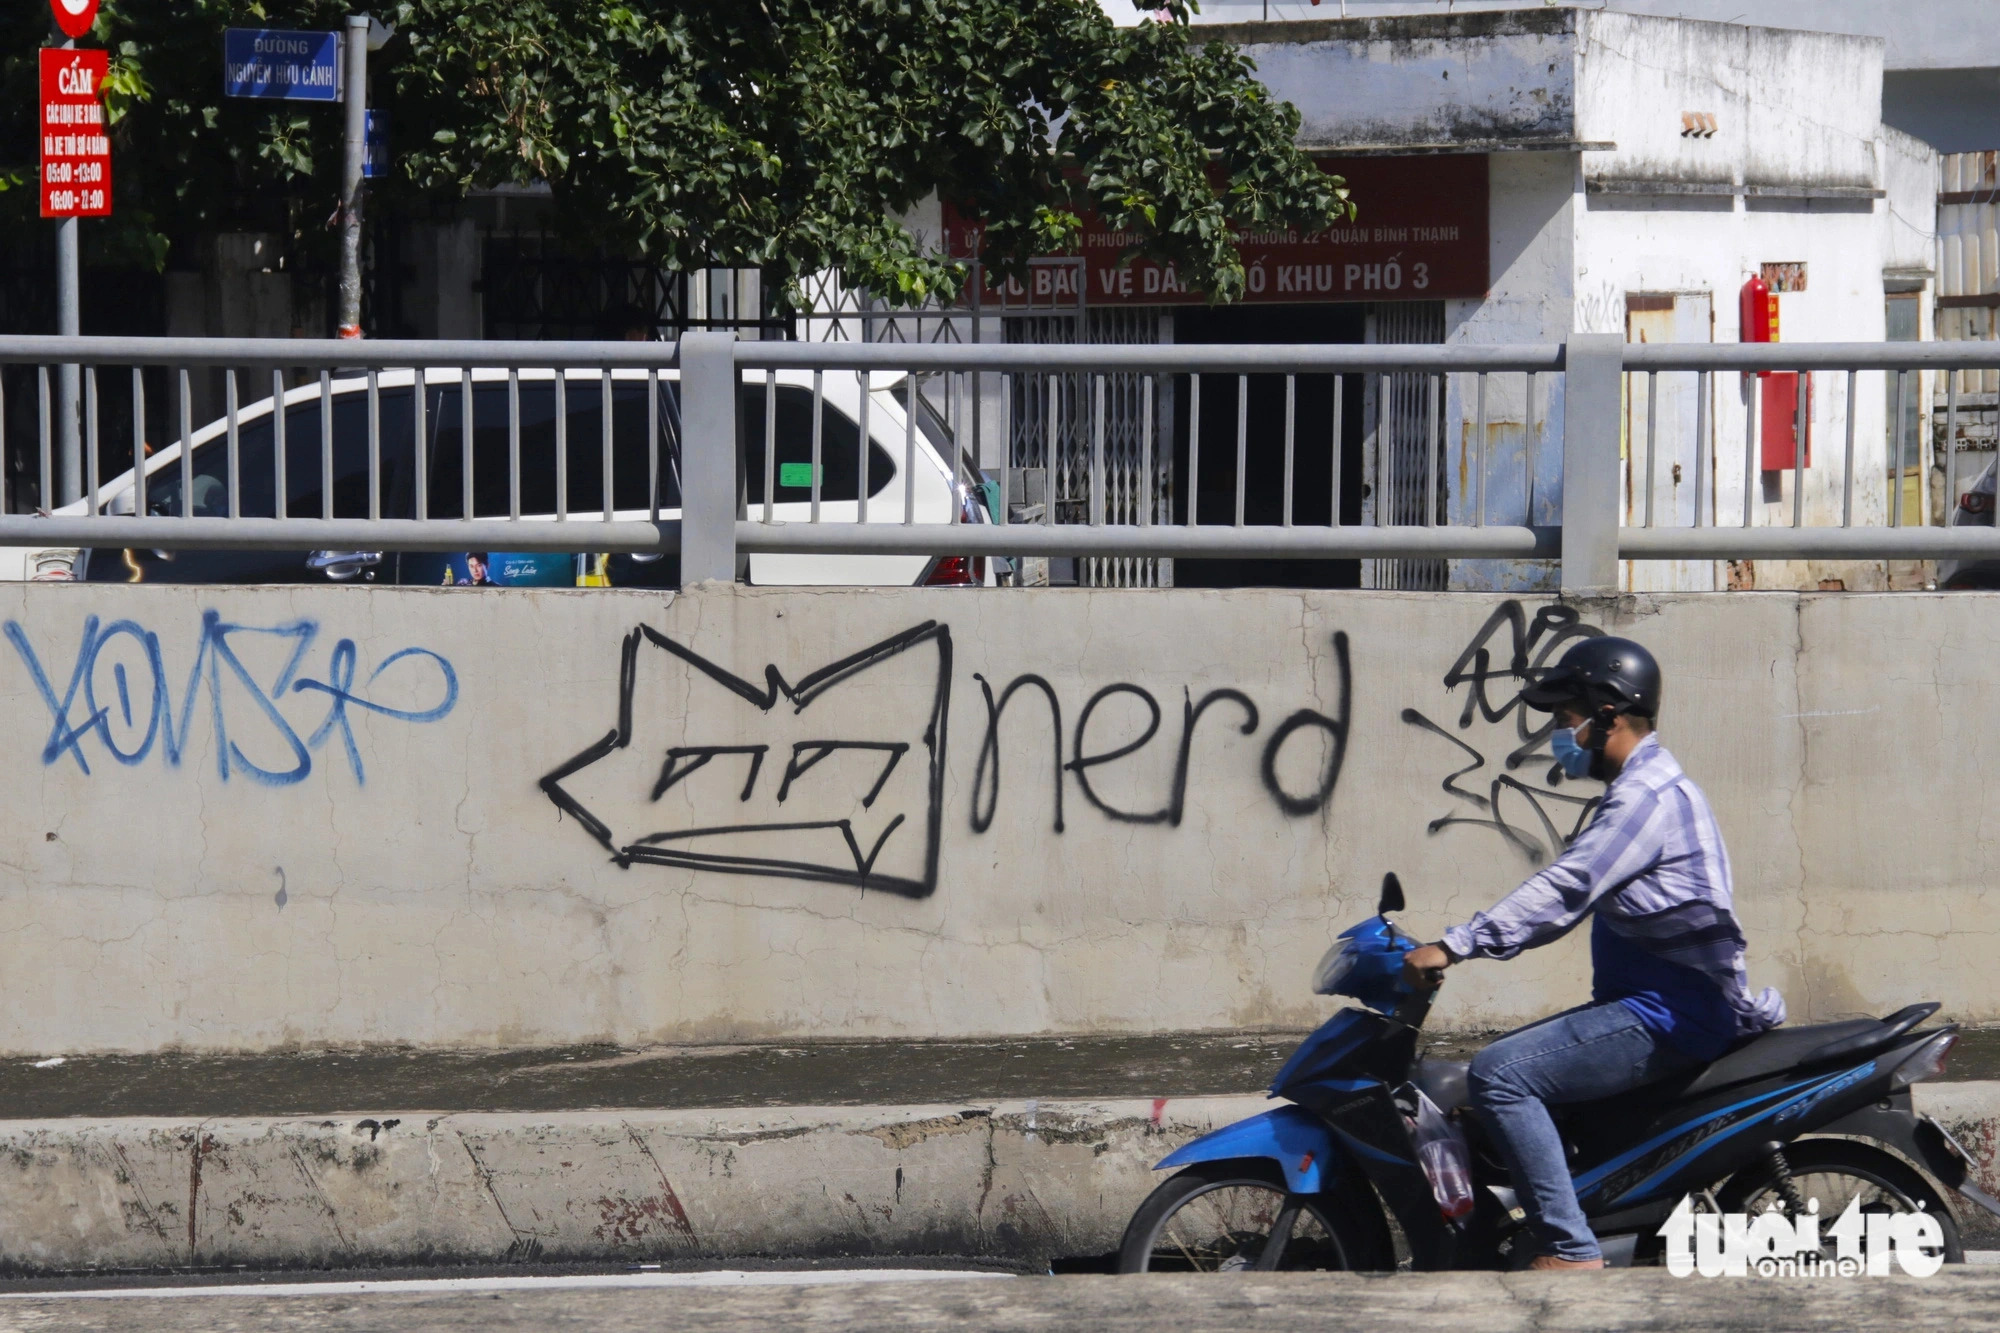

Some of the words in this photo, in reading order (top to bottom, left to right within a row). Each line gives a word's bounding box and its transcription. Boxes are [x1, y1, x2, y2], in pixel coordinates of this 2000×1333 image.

[253, 34, 309, 55] ĐƯỜNG
[58, 55, 93, 95] CẤM
[228, 56, 271, 84] NGUYỄN
[276, 60, 300, 85] HỮU
[302, 59, 334, 86] CẢNH
[75, 104, 83, 124] XE
[84, 104, 89, 124] 3
[55, 136, 64, 156] XE
[46, 162, 72, 183] 05:00
[1374, 225, 1408, 243] BÌNH
[1412, 225, 1459, 245] THẠNH
[1277, 264, 1332, 293] KHU
[1344, 251, 1404, 291] PHỐ
[1412, 261, 1430, 290] 3
[971, 630, 1352, 835] nerd
